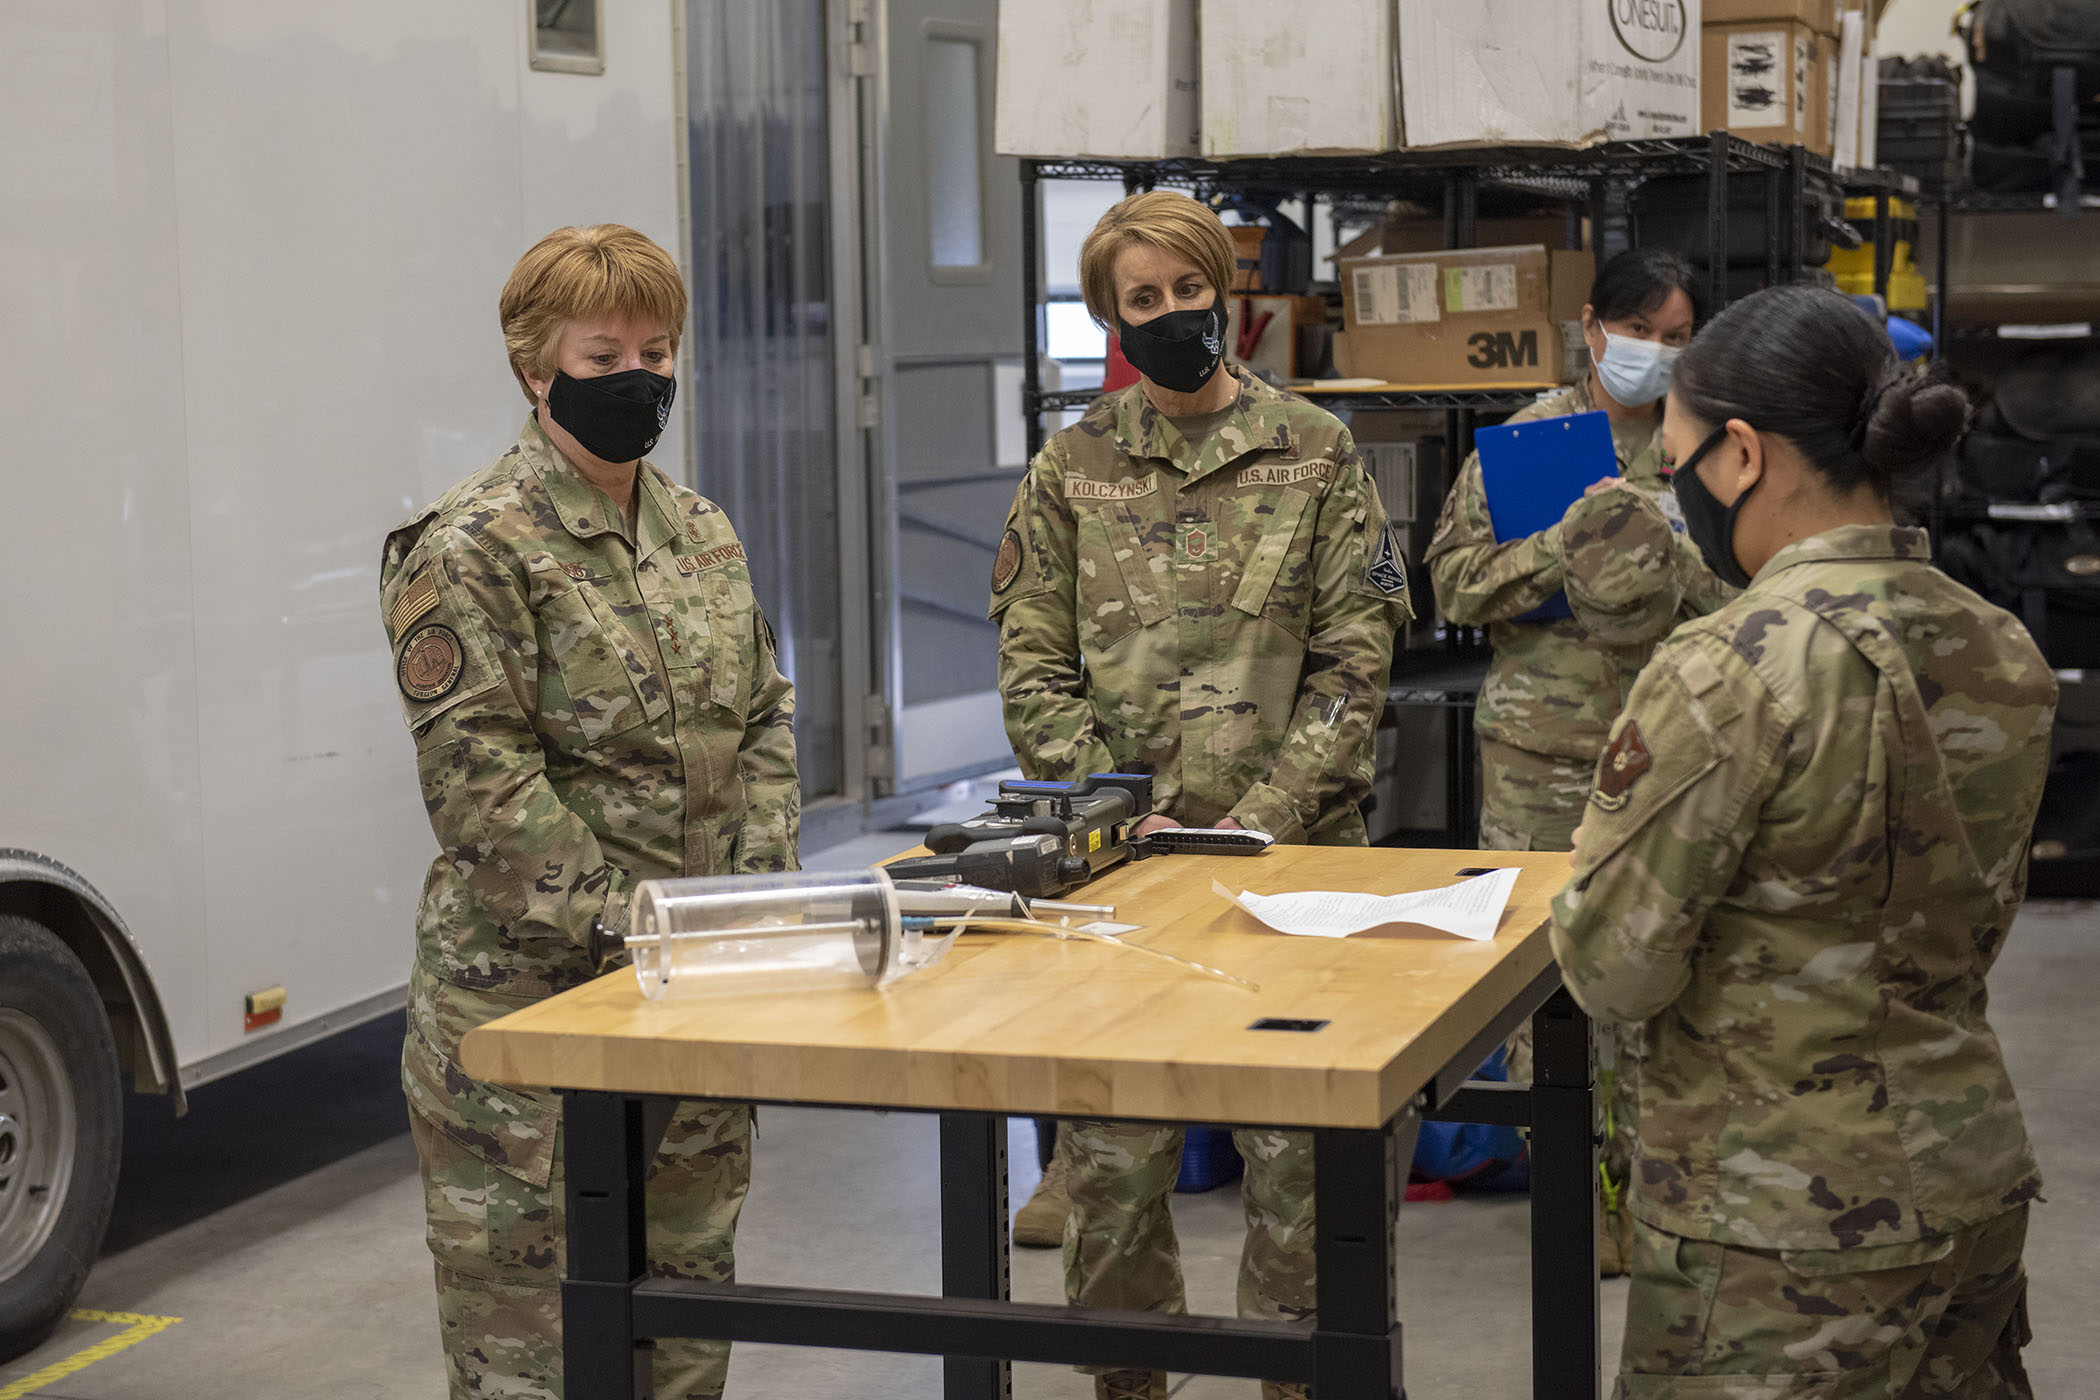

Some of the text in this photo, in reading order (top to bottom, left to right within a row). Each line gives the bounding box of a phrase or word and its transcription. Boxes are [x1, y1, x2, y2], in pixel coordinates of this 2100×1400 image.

[1467, 330, 1538, 368] 3M
[1240, 462, 1333, 484] U.S. AIR FORCE
[1072, 477, 1153, 497] KOLCZYNSKI
[696, 552, 715, 568] AIR
